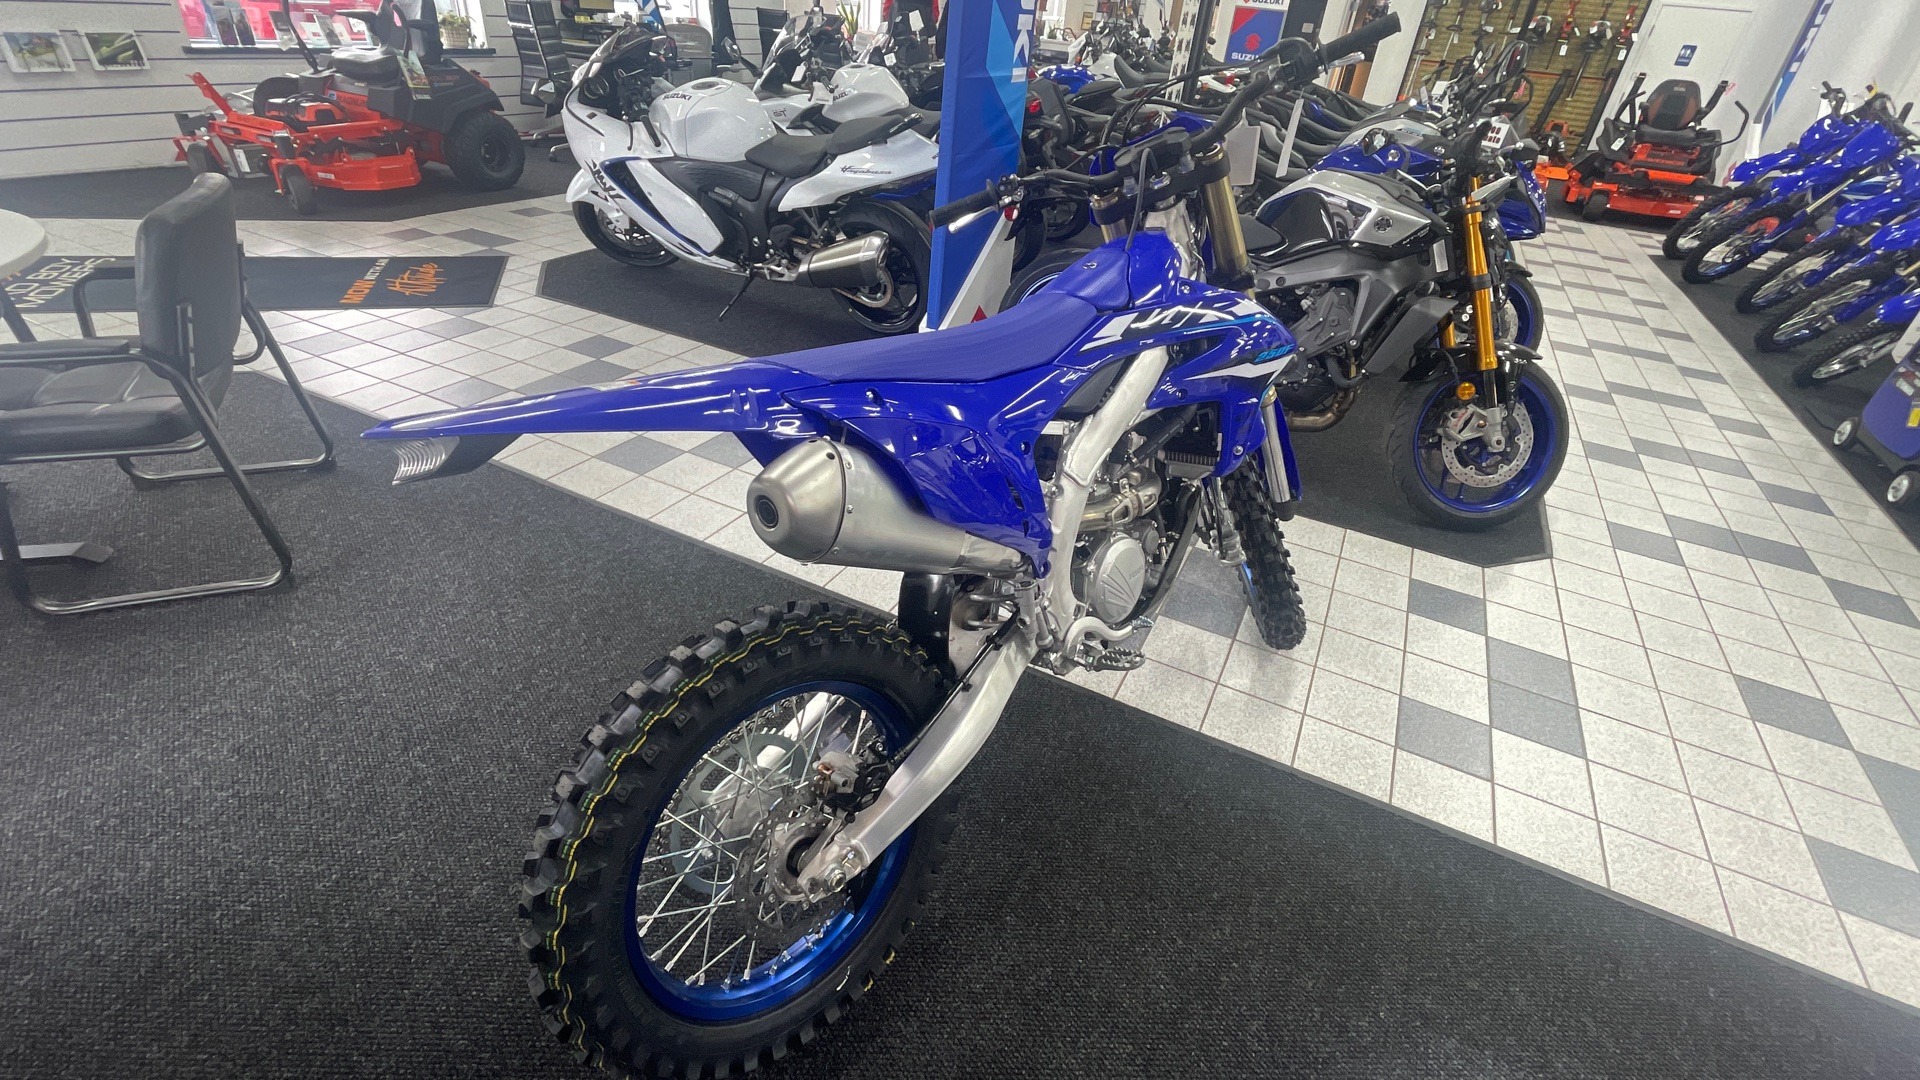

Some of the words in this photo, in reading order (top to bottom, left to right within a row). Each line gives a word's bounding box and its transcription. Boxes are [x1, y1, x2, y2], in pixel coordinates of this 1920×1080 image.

[662, 92, 693, 102] SUZUKI
[339, 278, 377, 304] MOW
[1254, 343, 1295, 363] 250F
